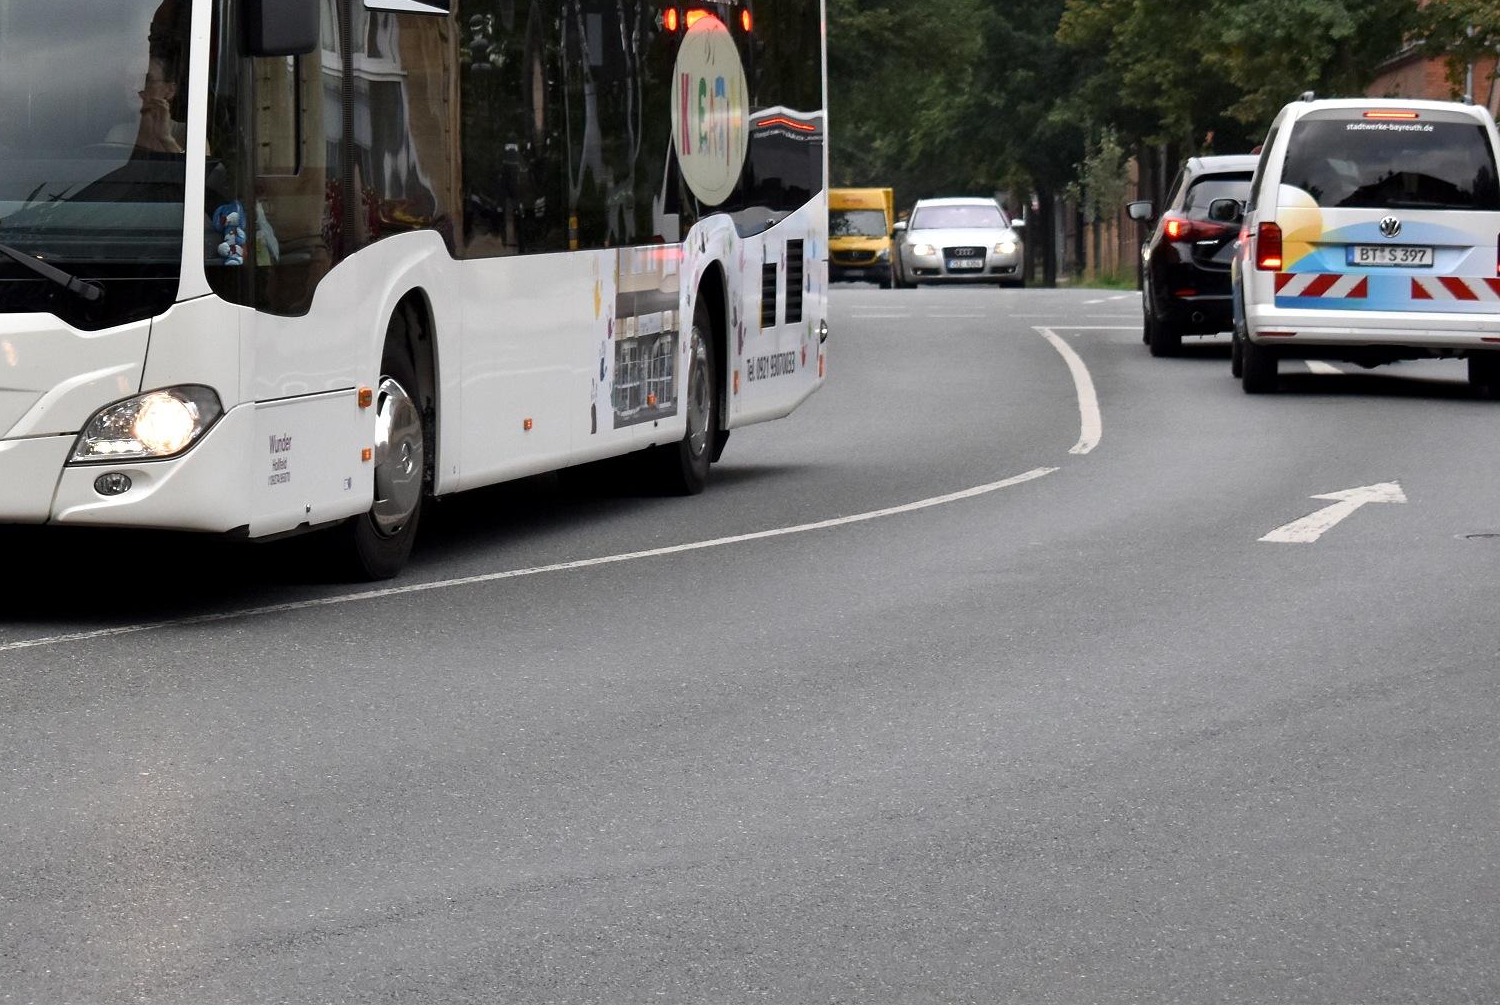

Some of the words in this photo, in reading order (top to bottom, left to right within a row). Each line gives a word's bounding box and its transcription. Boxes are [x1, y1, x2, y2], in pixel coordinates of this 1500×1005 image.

[1346, 122, 1434, 132] stadtwerke-bayreuth.de
[1360, 248, 1378, 261] BT
[1388, 248, 1397, 262] S
[1400, 248, 1427, 262] 397
[269, 433, 292, 454] Wunder
